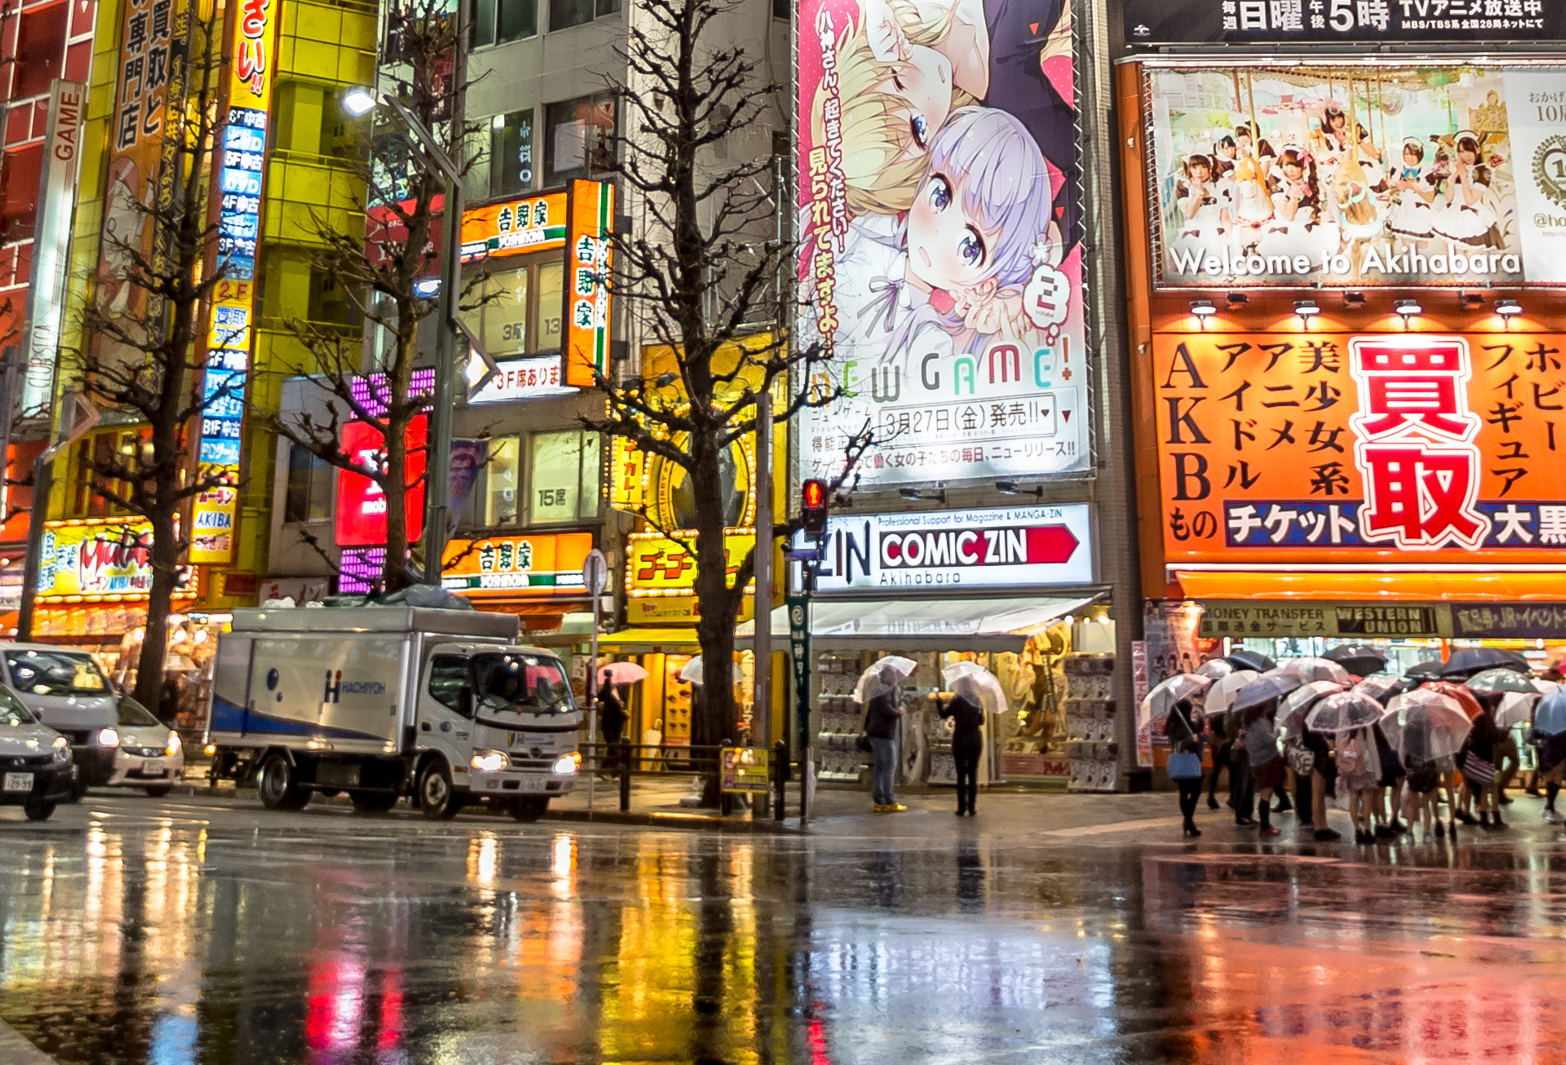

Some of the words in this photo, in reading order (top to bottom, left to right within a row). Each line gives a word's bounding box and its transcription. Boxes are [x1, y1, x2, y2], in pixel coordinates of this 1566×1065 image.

[56, 89, 81, 162] GAME
[1170, 247, 1312, 277] Welcome
[1321, 248, 1351, 274] to
[1360, 245, 1521, 275] Akihabara
[1260, 342, 1298, 449] アニメ
[1525, 342, 1564, 450] ホビー
[1216, 342, 1262, 490] アイドル
[1299, 341, 1350, 494] 美少女系
[1481, 343, 1531, 498] フィギュア
[1161, 341, 1219, 539] AKBもの
[1355, 342, 1479, 542] 買取
[197, 512, 231, 527] AKIBA
[878, 516, 919, 527] Professional
[923, 514, 951, 526] Support
[954, 514, 963, 523] for
[966, 512, 1003, 524] Magazine
[1014, 509, 1063, 520] MANGA-ZIN
[1229, 507, 1356, 542] チケット
[881, 529, 978, 567] COMIC
[984, 528, 1027, 564] ZIN
[880, 570, 961, 586] Akihabara
[1253, 608, 1324, 620] TRANSFER
[1336, 607, 1421, 621] WESTERN
[1365, 621, 1421, 633] UNION
